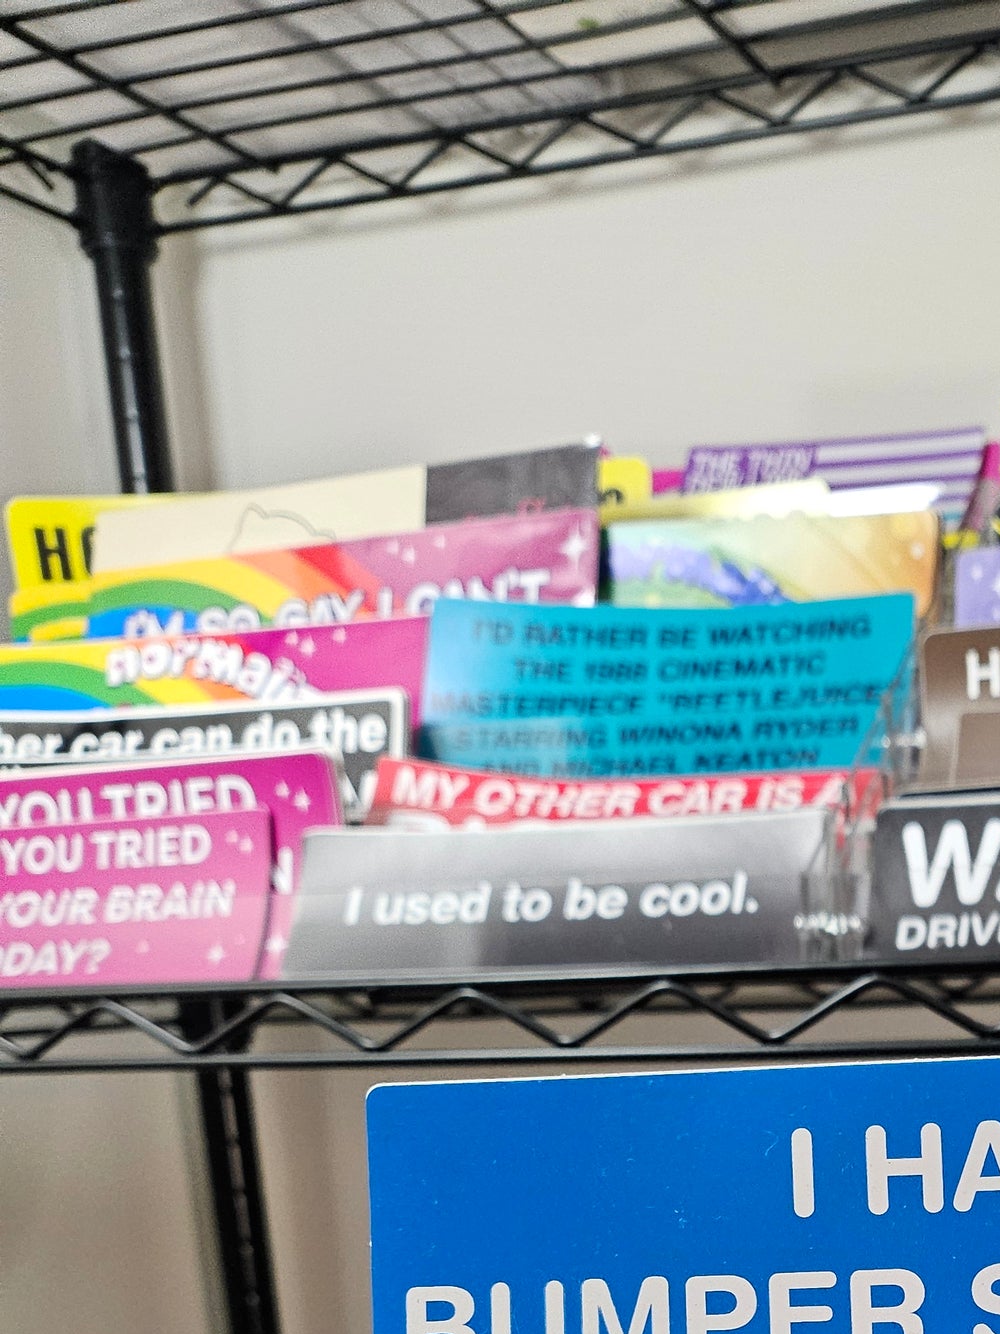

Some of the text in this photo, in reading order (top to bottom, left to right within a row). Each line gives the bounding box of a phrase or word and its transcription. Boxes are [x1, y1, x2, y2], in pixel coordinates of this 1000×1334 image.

[524, 620, 648, 647] RATHER
[658, 626, 697, 650] BE
[709, 613, 872, 646] WATCHING
[514, 657, 571, 684] THE
[658, 650, 826, 683] CINEMATIC
[69, 728, 145, 757] car
[151, 722, 233, 754] can
[242, 712, 301, 750] do
[309, 707, 387, 755] the
[620, 720, 741, 745] WINONA
[755, 715, 859, 739] RYDER
[391, 766, 468, 810] MY
[474, 777, 640, 821] OTHER
[646, 774, 745, 817] CAR
[755, 774, 801, 812] IS
[1, 822, 213, 876] YOU TRIED
[104, 878, 237, 925] BRAIN
[343, 869, 760, 925] I used to be cool.
[791, 1127, 815, 1218] I
